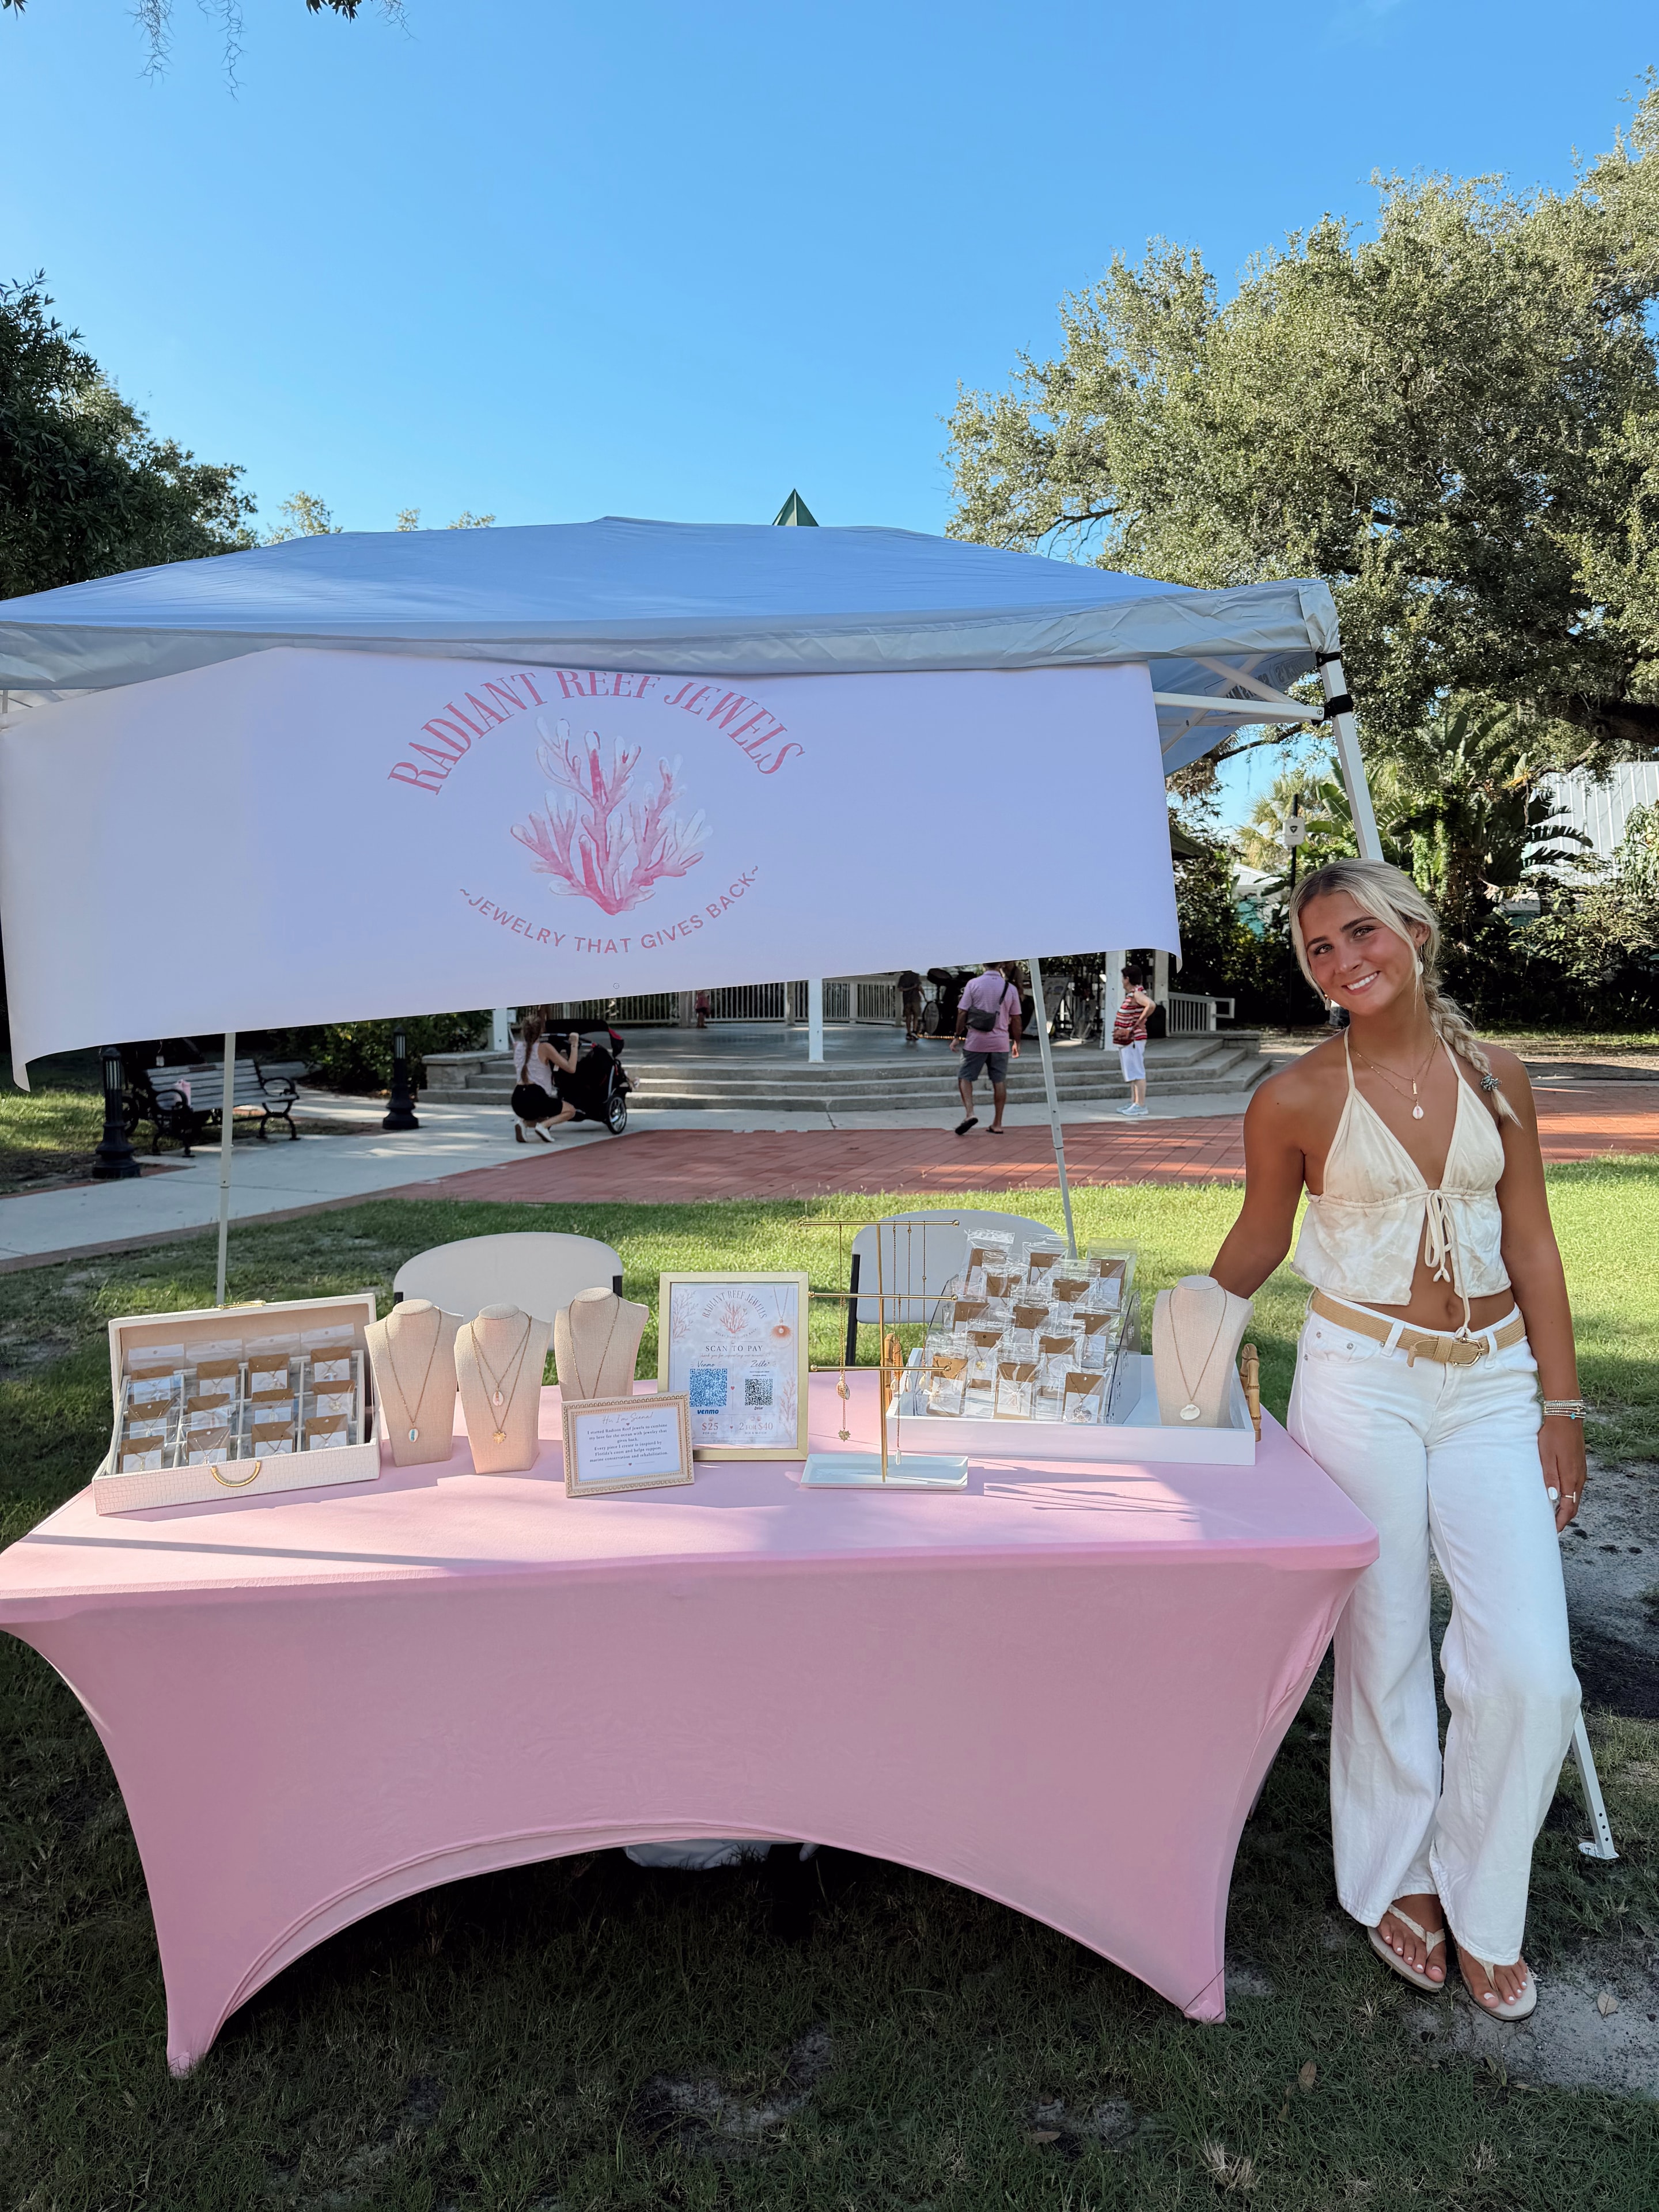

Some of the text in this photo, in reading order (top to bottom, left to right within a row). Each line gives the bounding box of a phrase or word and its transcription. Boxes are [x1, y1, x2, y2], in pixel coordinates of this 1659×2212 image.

[387, 670, 806, 796] RADIANT REEF JEWELS
[574, 937, 631, 954] THAT
[641, 915, 704, 949] GIVES
[702, 1290, 767, 1319] RADIANT REEF JEWELS
[702, 1422, 719, 1431] $25
[739, 1422, 744, 1430] 2
[758, 1422, 773, 1431] $40
